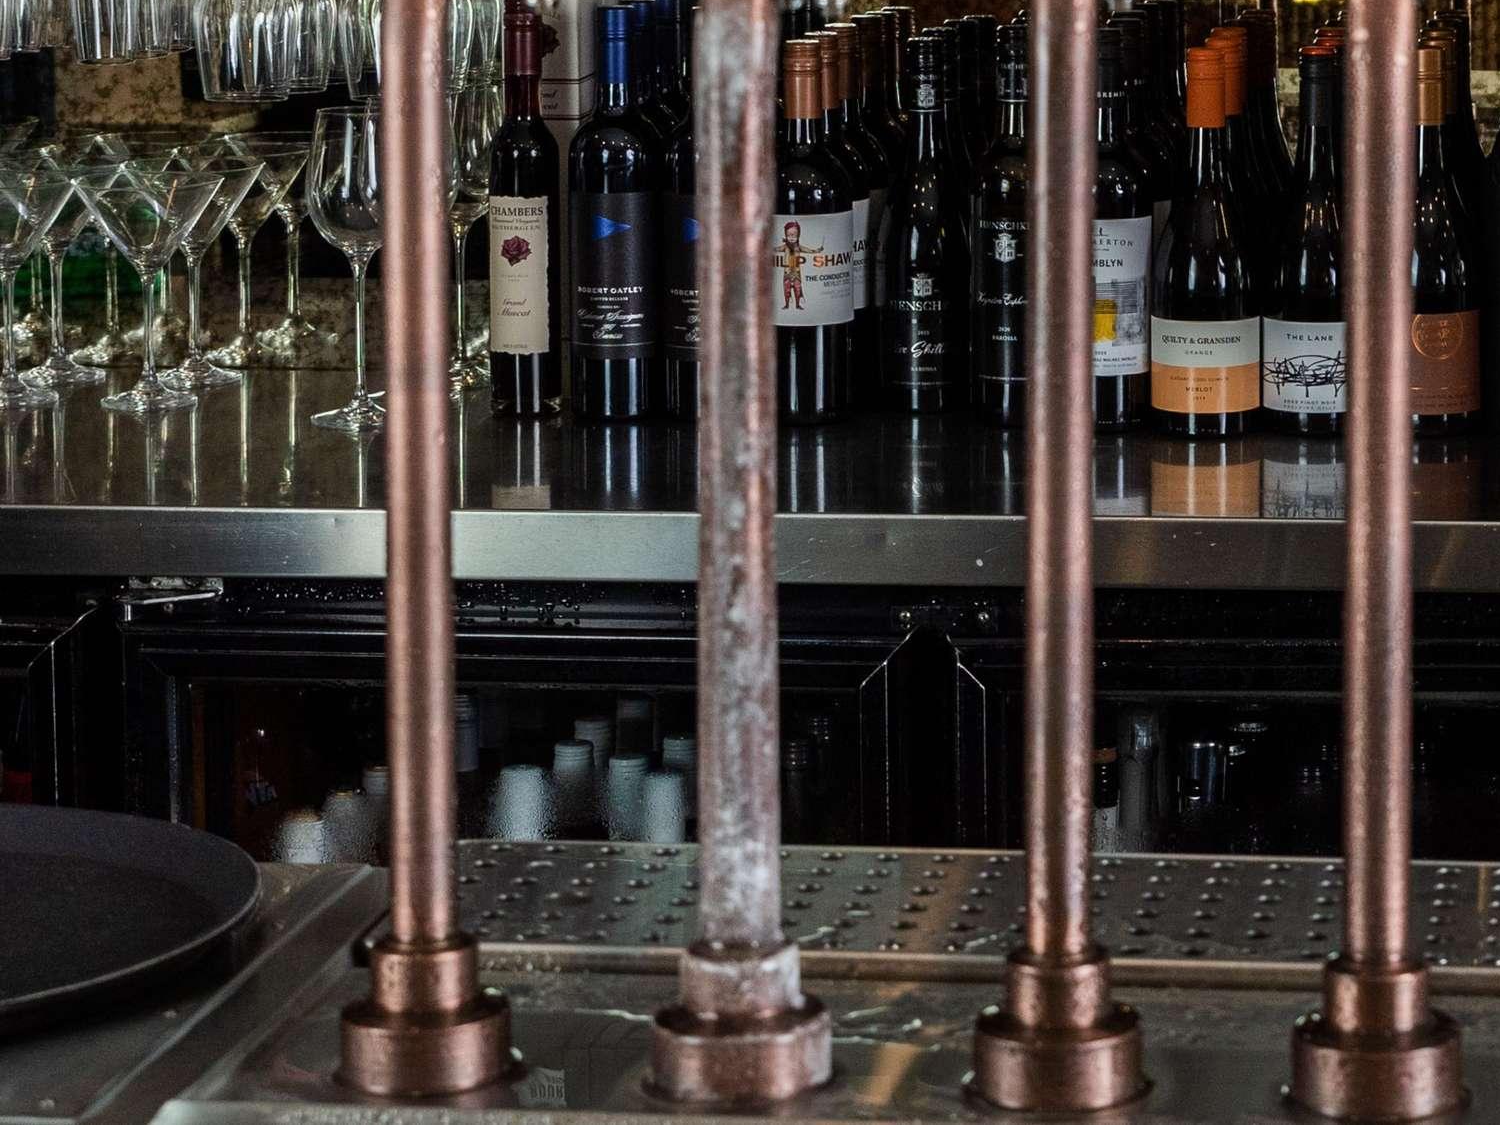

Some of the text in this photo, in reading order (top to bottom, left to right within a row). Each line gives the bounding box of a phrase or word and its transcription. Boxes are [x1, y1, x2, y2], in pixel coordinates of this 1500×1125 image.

[490, 206, 544, 217] CHAMBERS
[812, 251, 854, 268] SHAW
[577, 285, 645, 295] ROBERT OATLEY
[1161, 335, 1188, 344] QUILTY
[1197, 335, 1241, 345] GRANSDEN
[1286, 333, 1335, 342] THE LANE
